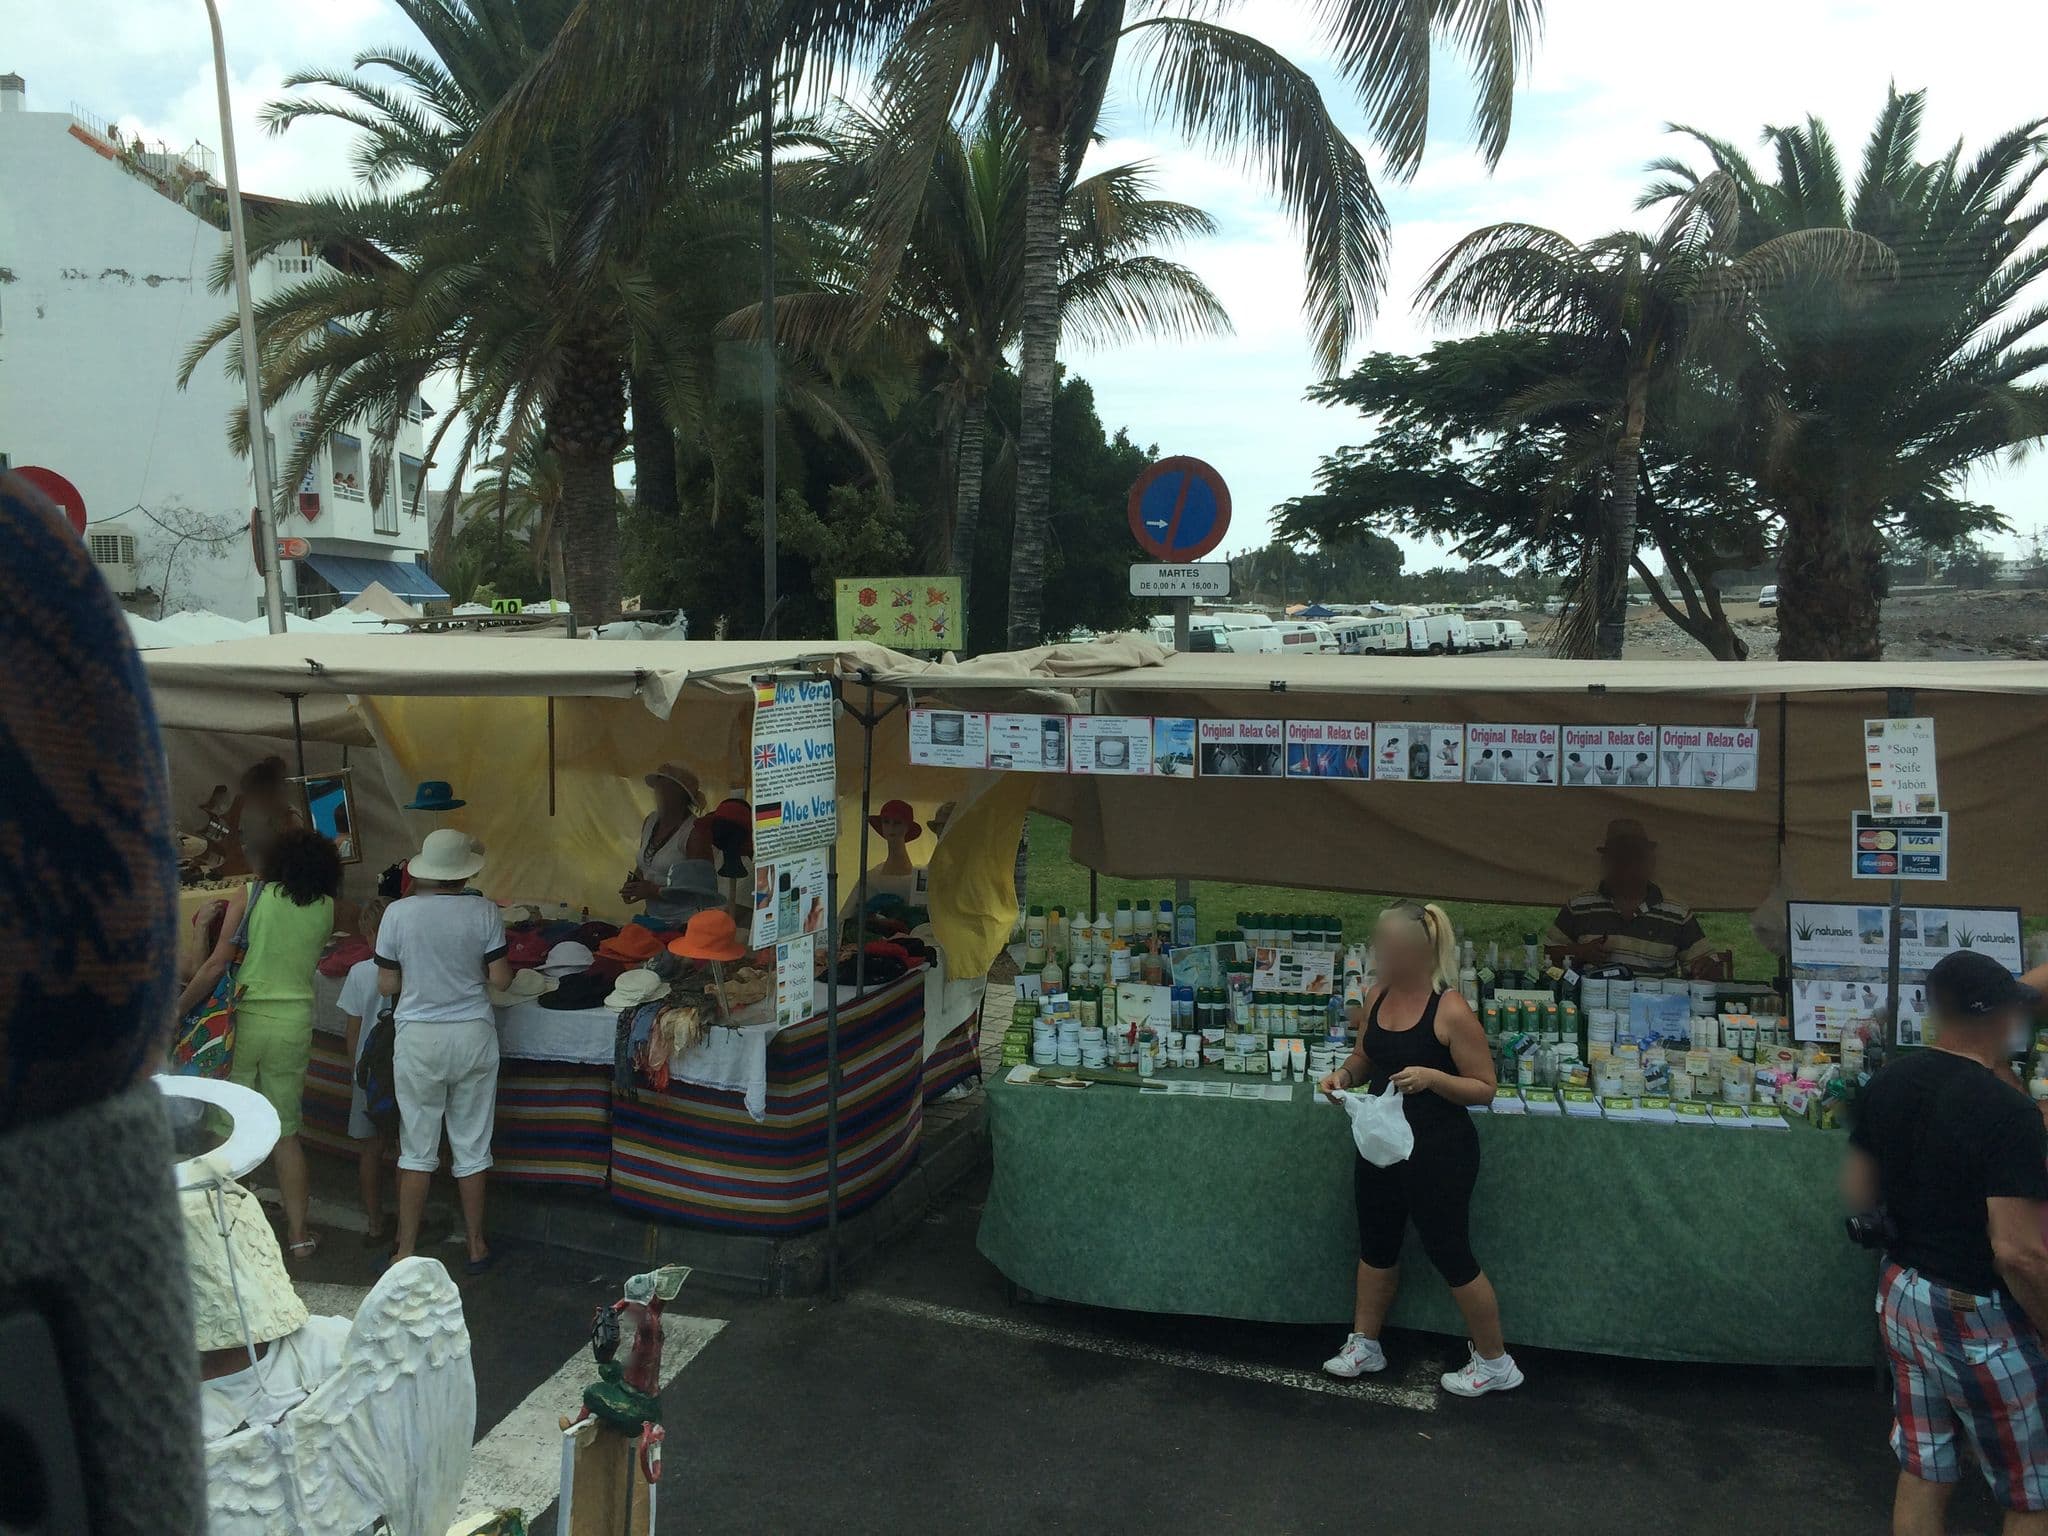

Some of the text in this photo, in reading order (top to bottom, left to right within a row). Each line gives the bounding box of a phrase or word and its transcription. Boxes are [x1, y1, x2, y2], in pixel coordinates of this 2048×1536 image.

[1159, 569, 1200, 578] MARTES
[1140, 582, 1151, 590] DE
[1171, 582, 1176, 590] h
[1180, 582, 1186, 590] A
[1213, 582, 1219, 590] h
[495, 601, 519, 614] 10
[775, 681, 831, 705] Aloe Vera
[1202, 723, 1235, 741] Original
[1239, 724, 1263, 738] Relax
[1265, 724, 1280, 738] Gel
[1289, 724, 1369, 742] Original Relax Gel
[1470, 728, 1556, 746] Original Relax Gel
[1566, 730, 1654, 748] Original Relax Gel
[1663, 730, 1754, 749] Original Relax Gel
[777, 738, 834, 766] Aloe Vera
[783, 799, 809, 824] Aloe
[1908, 836, 1934, 845] VISA
[1815, 925, 1853, 937] naturales
[1976, 932, 2016, 944] naturales
